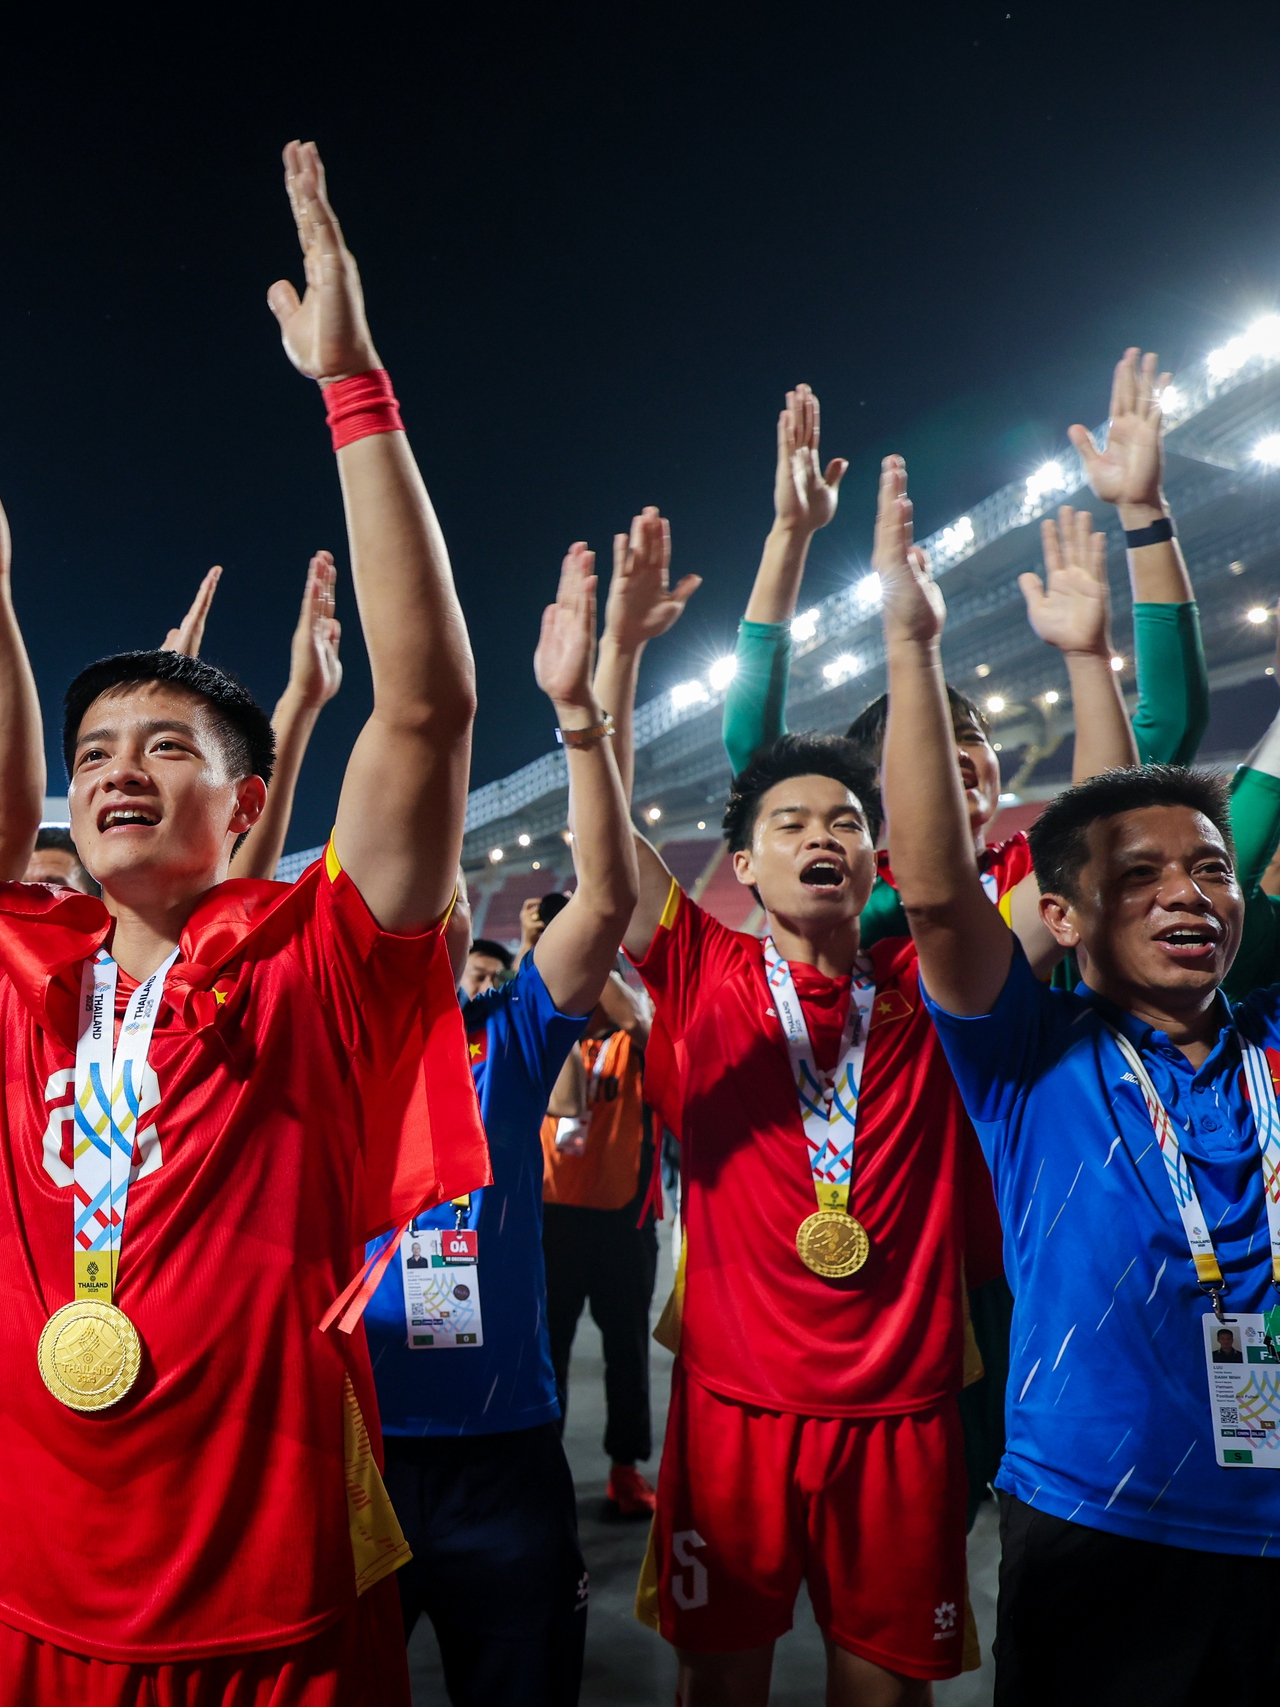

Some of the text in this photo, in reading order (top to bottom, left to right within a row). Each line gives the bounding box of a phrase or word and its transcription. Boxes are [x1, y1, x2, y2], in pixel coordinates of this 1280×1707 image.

[134, 976, 156, 1020] THAILAND
[92, 994, 104, 1040] THAILAND
[782, 1001, 796, 1034] THAILAND
[450, 1240, 468, 1253] OA
[62, 1362, 114, 1376] THAILAND
